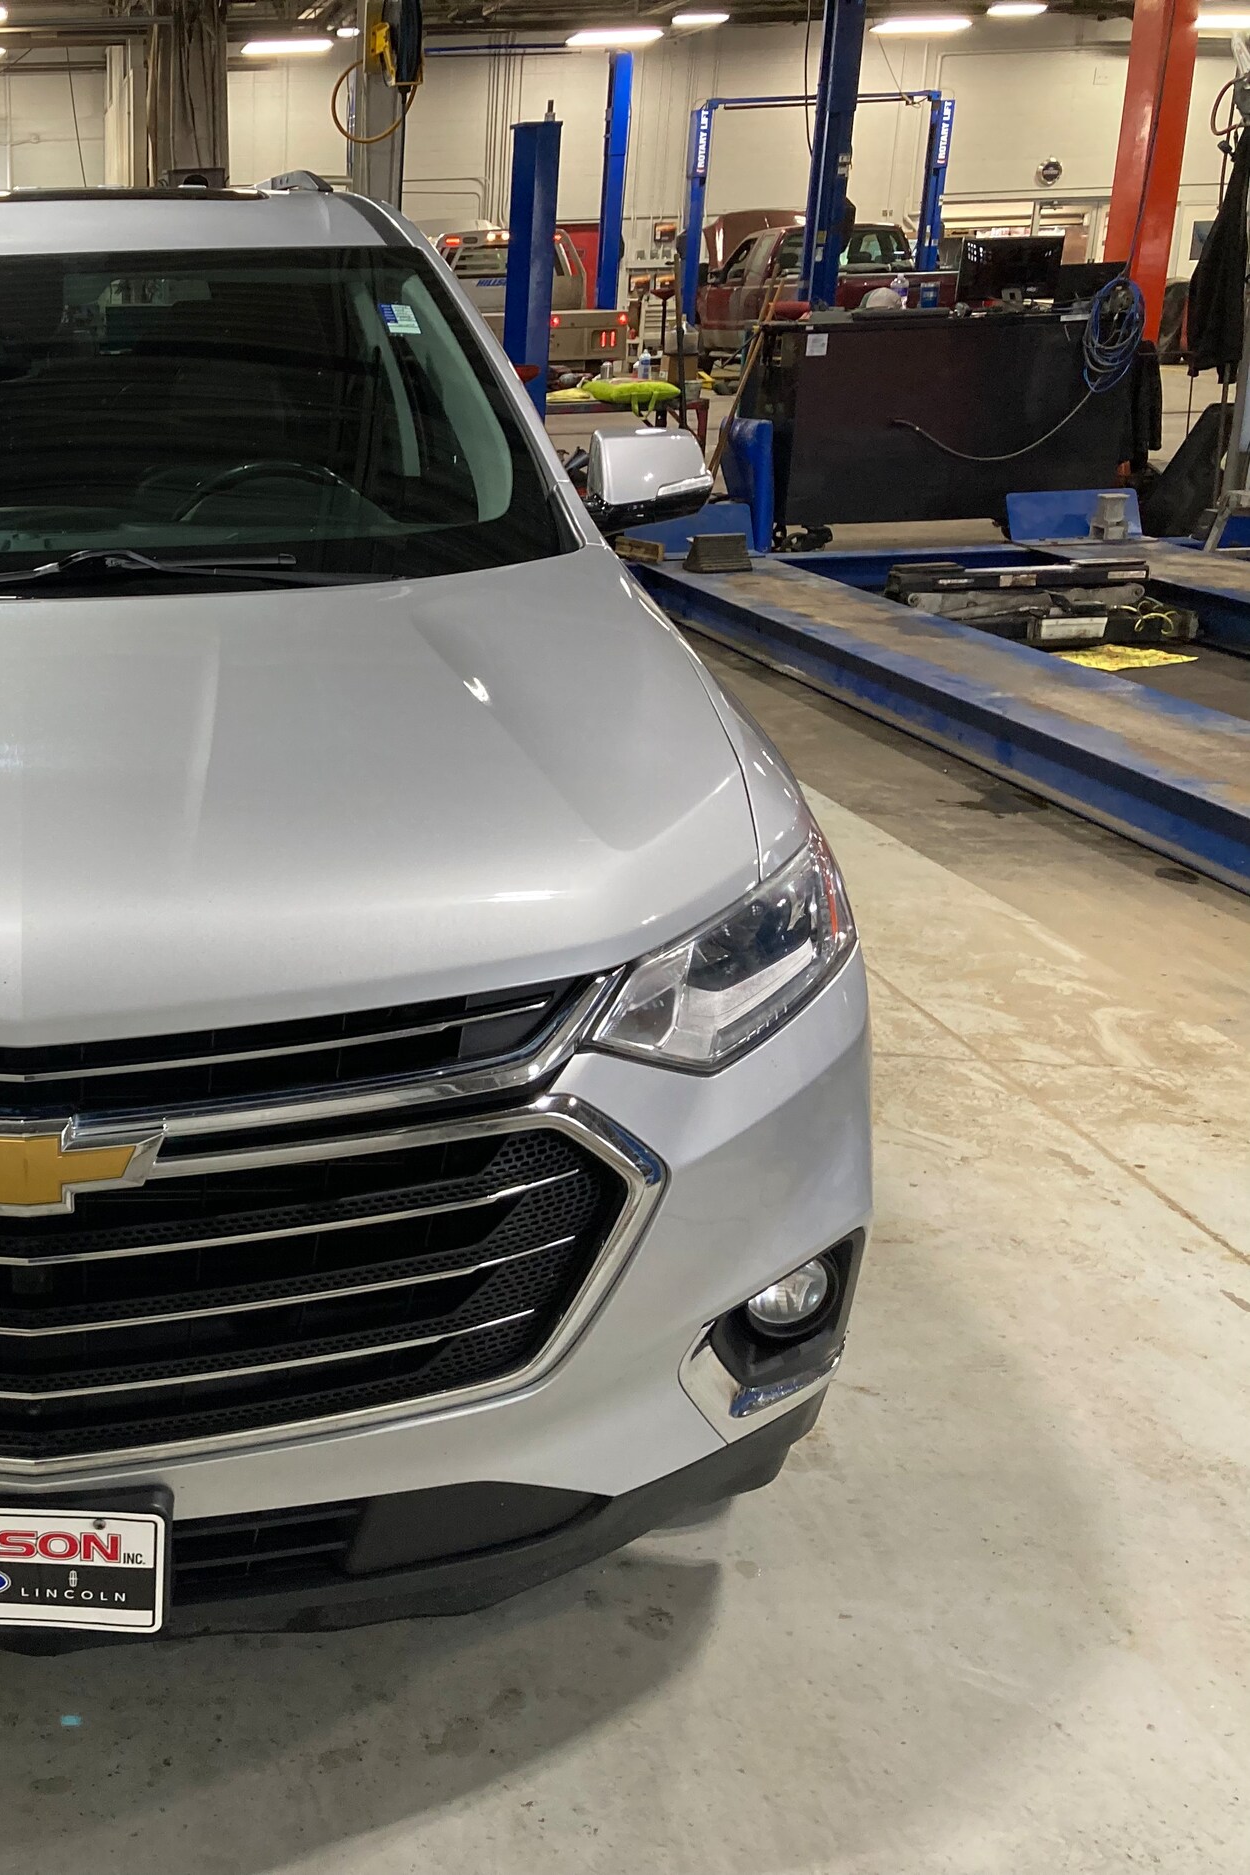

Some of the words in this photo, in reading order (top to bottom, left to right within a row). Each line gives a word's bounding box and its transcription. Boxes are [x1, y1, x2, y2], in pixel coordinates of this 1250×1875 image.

[700, 110, 709, 129] LIFT
[942, 100, 952, 120] LIFT
[697, 131, 707, 168] ROTARY
[938, 122, 949, 159] ROTARY
[122, 1552, 146, 1565] INC.
[20, 1588, 127, 1602] LINCOLN
